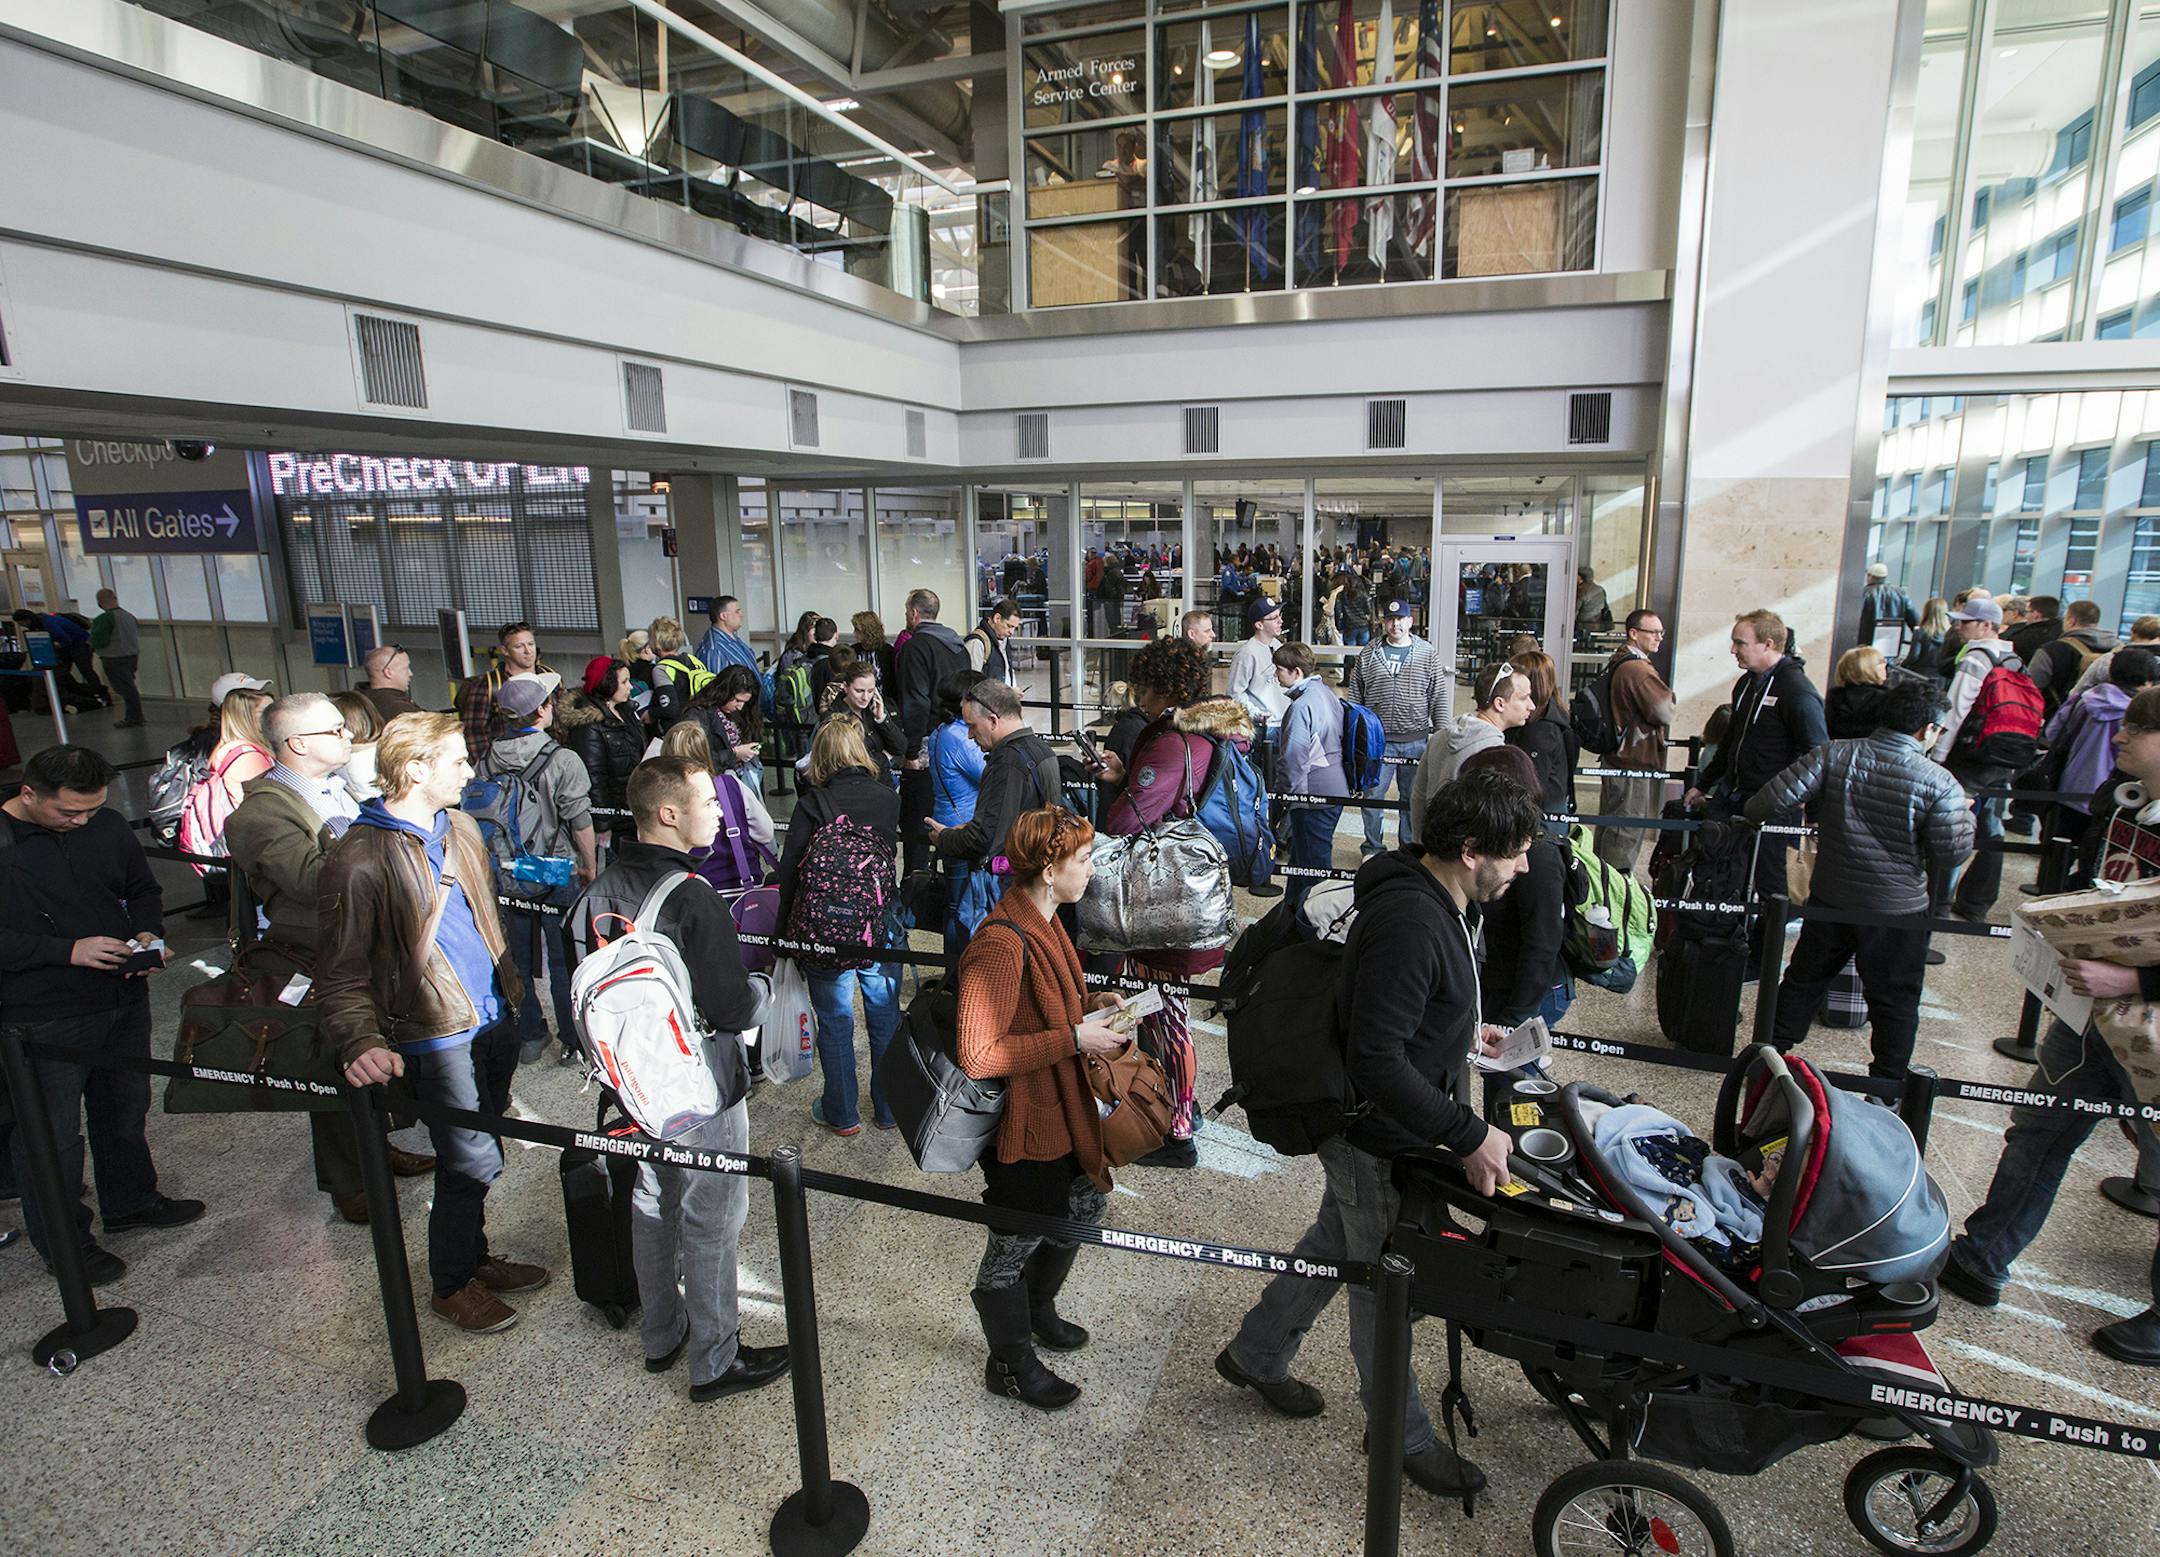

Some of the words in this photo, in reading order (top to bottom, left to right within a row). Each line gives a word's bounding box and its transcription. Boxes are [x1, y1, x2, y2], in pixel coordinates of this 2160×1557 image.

[1036, 62, 1083, 83] Armed
[1090, 59, 1135, 75] Forces
[1034, 86, 1084, 105] Service
[1089, 80, 1136, 97] Center
[75, 439, 176, 469] Checkpo
[268, 452, 456, 496] PreCheck
[113, 509, 140, 538] All
[145, 507, 216, 538] Gates
[1583, 768, 1622, 777] EMERGENCY
[1628, 770, 1643, 778] Push
[1309, 796, 1327, 804] Open
[1560, 814, 1580, 823] Open
[1761, 825, 1812, 835] EMERGENCY
[1281, 867, 1332, 877] EMERGENCY
[516, 900, 532, 909] Push
[533, 903, 540, 911] to
[542, 904, 559, 914] Open
[1679, 901, 1702, 910] Push
[1705, 902, 1716, 911] to
[1719, 903, 1745, 913] Open
[737, 933, 770, 946] RGENCY
[778, 938, 799, 950] Push
[801, 942, 811, 951] to
[814, 943, 836, 954] Open
[1120, 978, 1144, 990] Push
[1148, 982, 1159, 991] to
[1163, 984, 1189, 995] Open
[1550, 1036, 1568, 1047] sh
[1573, 1038, 1586, 1049] to
[1591, 1041, 1625, 1055] Open
[192, 1067, 255, 1085] EMERGENCY
[266, 1077, 292, 1090] Push
[294, 1081, 306, 1092] to
[310, 1082, 338, 1096] Open
[620, 1061, 650, 1106] patagonia
[1960, 1085, 2057, 1108] EMERGENCY
[2074, 1099, 2112, 1115] Push
[2118, 1104, 2135, 1117] to
[2141, 1107, 2160, 1122] Op
[575, 1133, 652, 1158] EMERGENCY
[663, 1148, 693, 1165] Push
[698, 1152, 712, 1167] to
[716, 1155, 748, 1172] Open
[1102, 1230, 1203, 1259] EMERGENCY
[1222, 1250, 1263, 1268] Push
[1269, 1256, 1287, 1272] to
[1294, 1260, 1338, 1278] Open
[1871, 1384, 2022, 1429] EMERGENCY
[2049, 1418, 2110, 1446] Push
[2120, 1432, 2147, 1452] to
